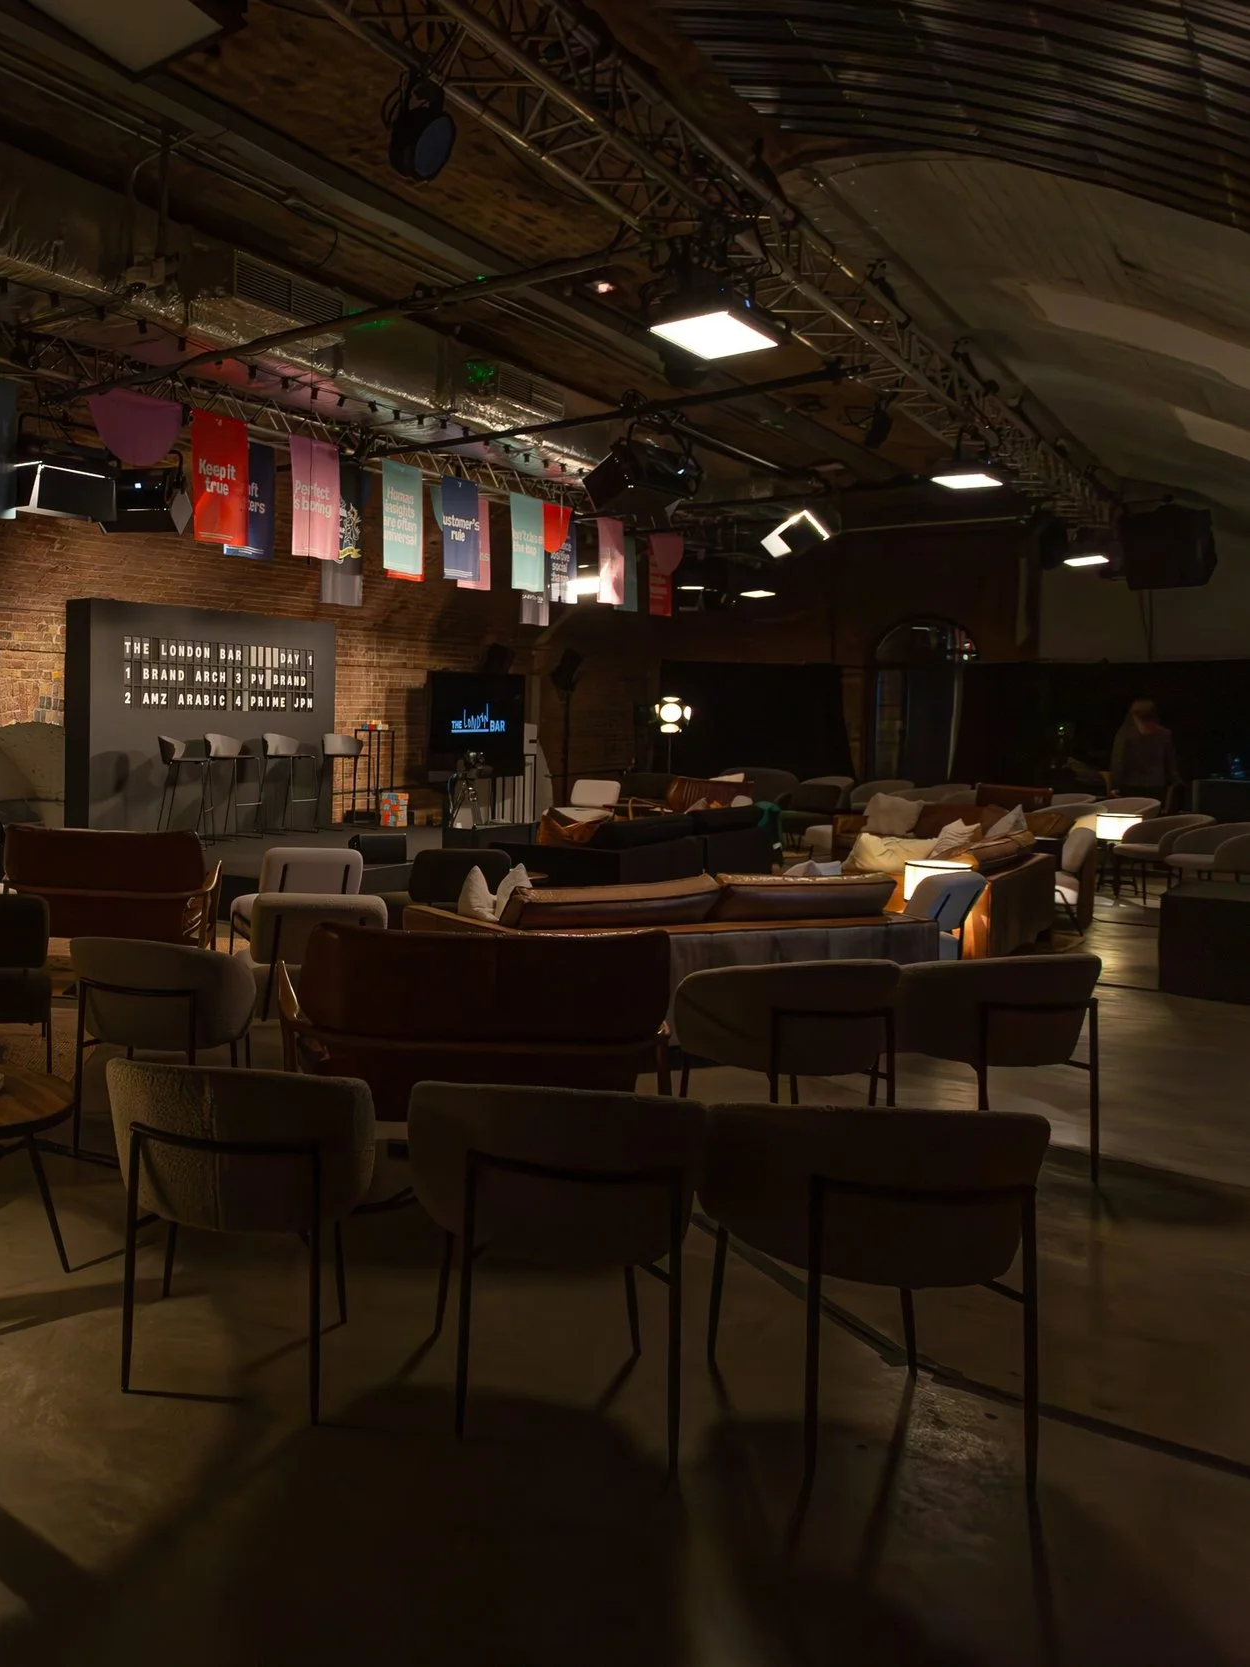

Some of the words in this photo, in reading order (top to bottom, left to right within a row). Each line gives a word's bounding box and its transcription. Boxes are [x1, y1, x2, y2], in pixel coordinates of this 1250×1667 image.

[198, 457, 226, 481] Keep
[227, 464, 237, 481] it
[205, 477, 230, 496] true
[294, 479, 331, 501] Perfect
[386, 486, 414, 505] Human
[442, 512, 481, 531] ustomer's
[450, 529, 466, 543] rule
[124, 641, 150, 655] THE
[161, 644, 211, 659] LONDON
[220, 648, 242, 661] BAR
[280, 652, 300, 665] DAY
[307, 655, 313, 666] 1
[125, 667, 131, 679] 1
[143, 668, 185, 682] BRAND
[195, 670, 227, 683] ARCH
[235, 672, 242, 684] 3
[251, 673, 265, 686] PV
[273, 674, 307, 687] BRAND
[124, 692, 131, 705] 2
[143, 692, 168, 705] AMZ
[178, 693, 226, 707] ARABIC
[235, 695, 242, 708] 4
[250, 696, 287, 709] PRIME
[294, 697, 313, 709] JPN
[451, 720, 463, 729] THE
[490, 719, 506, 733] BAR
